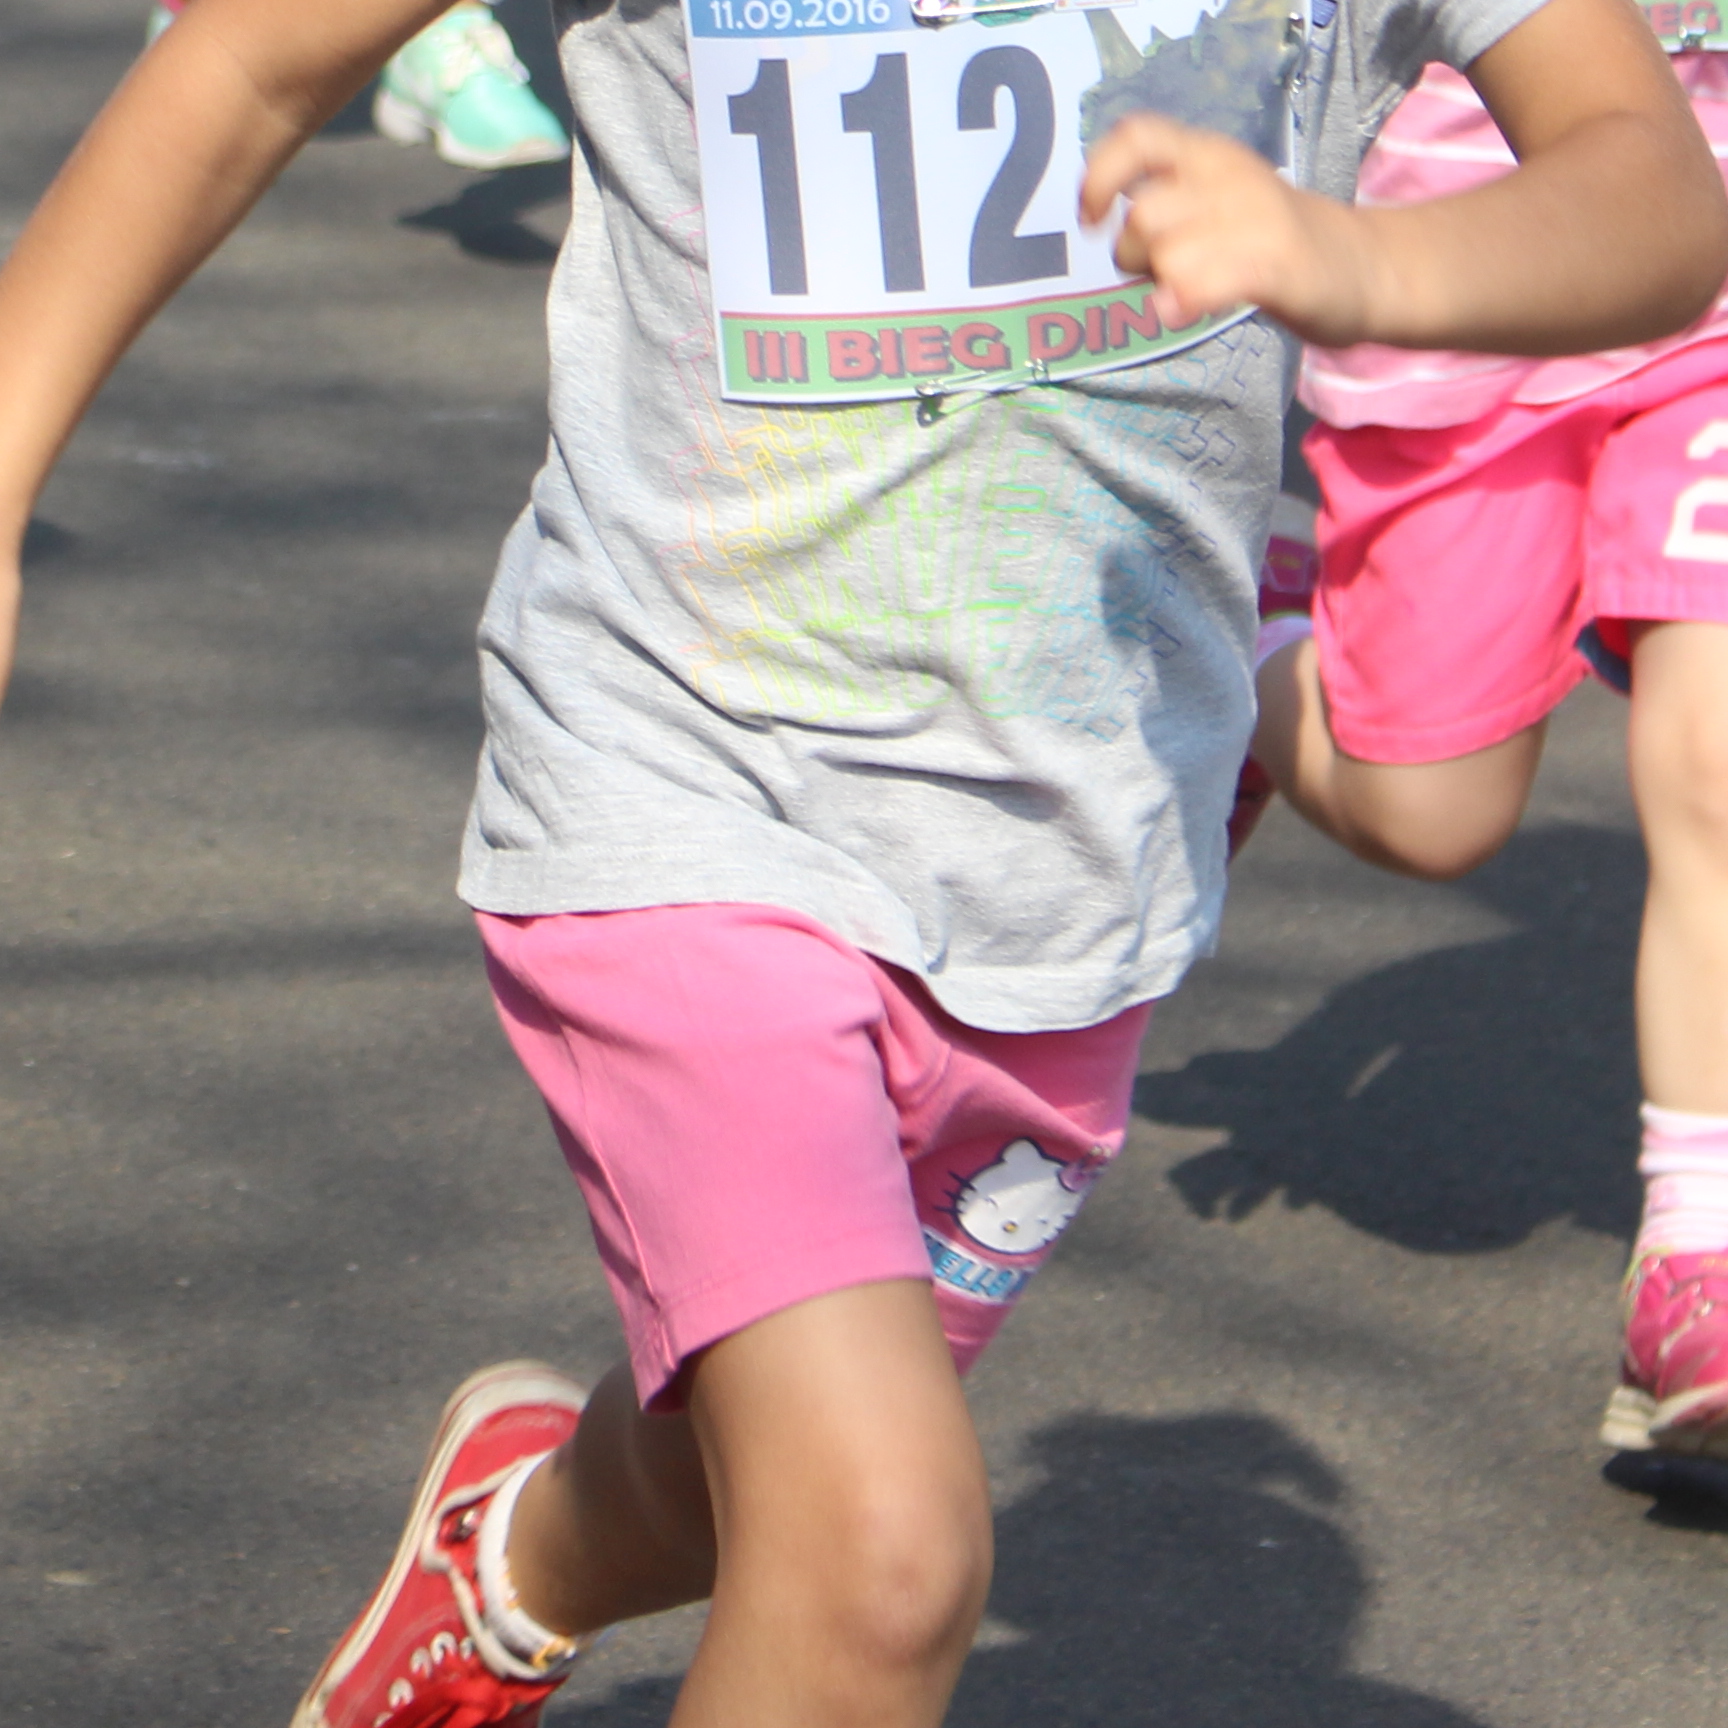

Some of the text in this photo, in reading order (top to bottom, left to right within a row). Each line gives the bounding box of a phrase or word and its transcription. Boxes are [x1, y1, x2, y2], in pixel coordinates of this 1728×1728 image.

[726, 44, 1070, 296] 112
[744, 329, 809, 383] III
[826, 320, 1012, 383] BIEG
